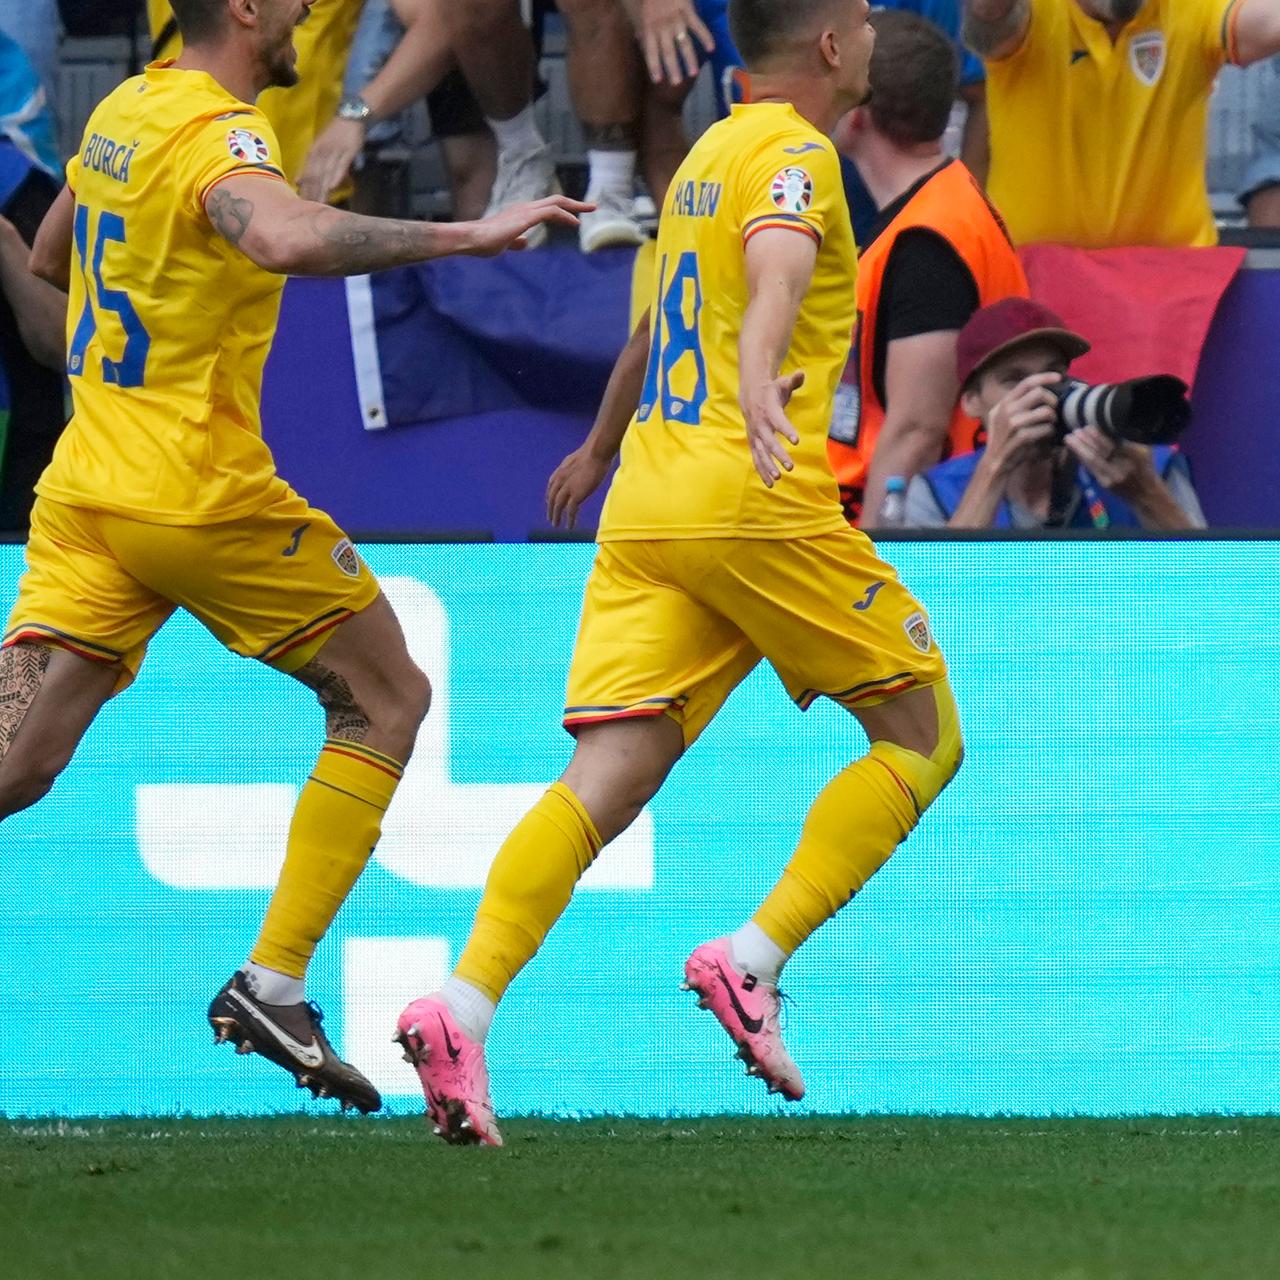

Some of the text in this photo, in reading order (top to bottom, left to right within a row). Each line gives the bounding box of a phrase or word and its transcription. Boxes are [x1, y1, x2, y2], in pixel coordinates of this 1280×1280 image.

[82, 132, 141, 184] BURCĂ
[67, 204, 152, 388] 15
[636, 250, 709, 426] 18
